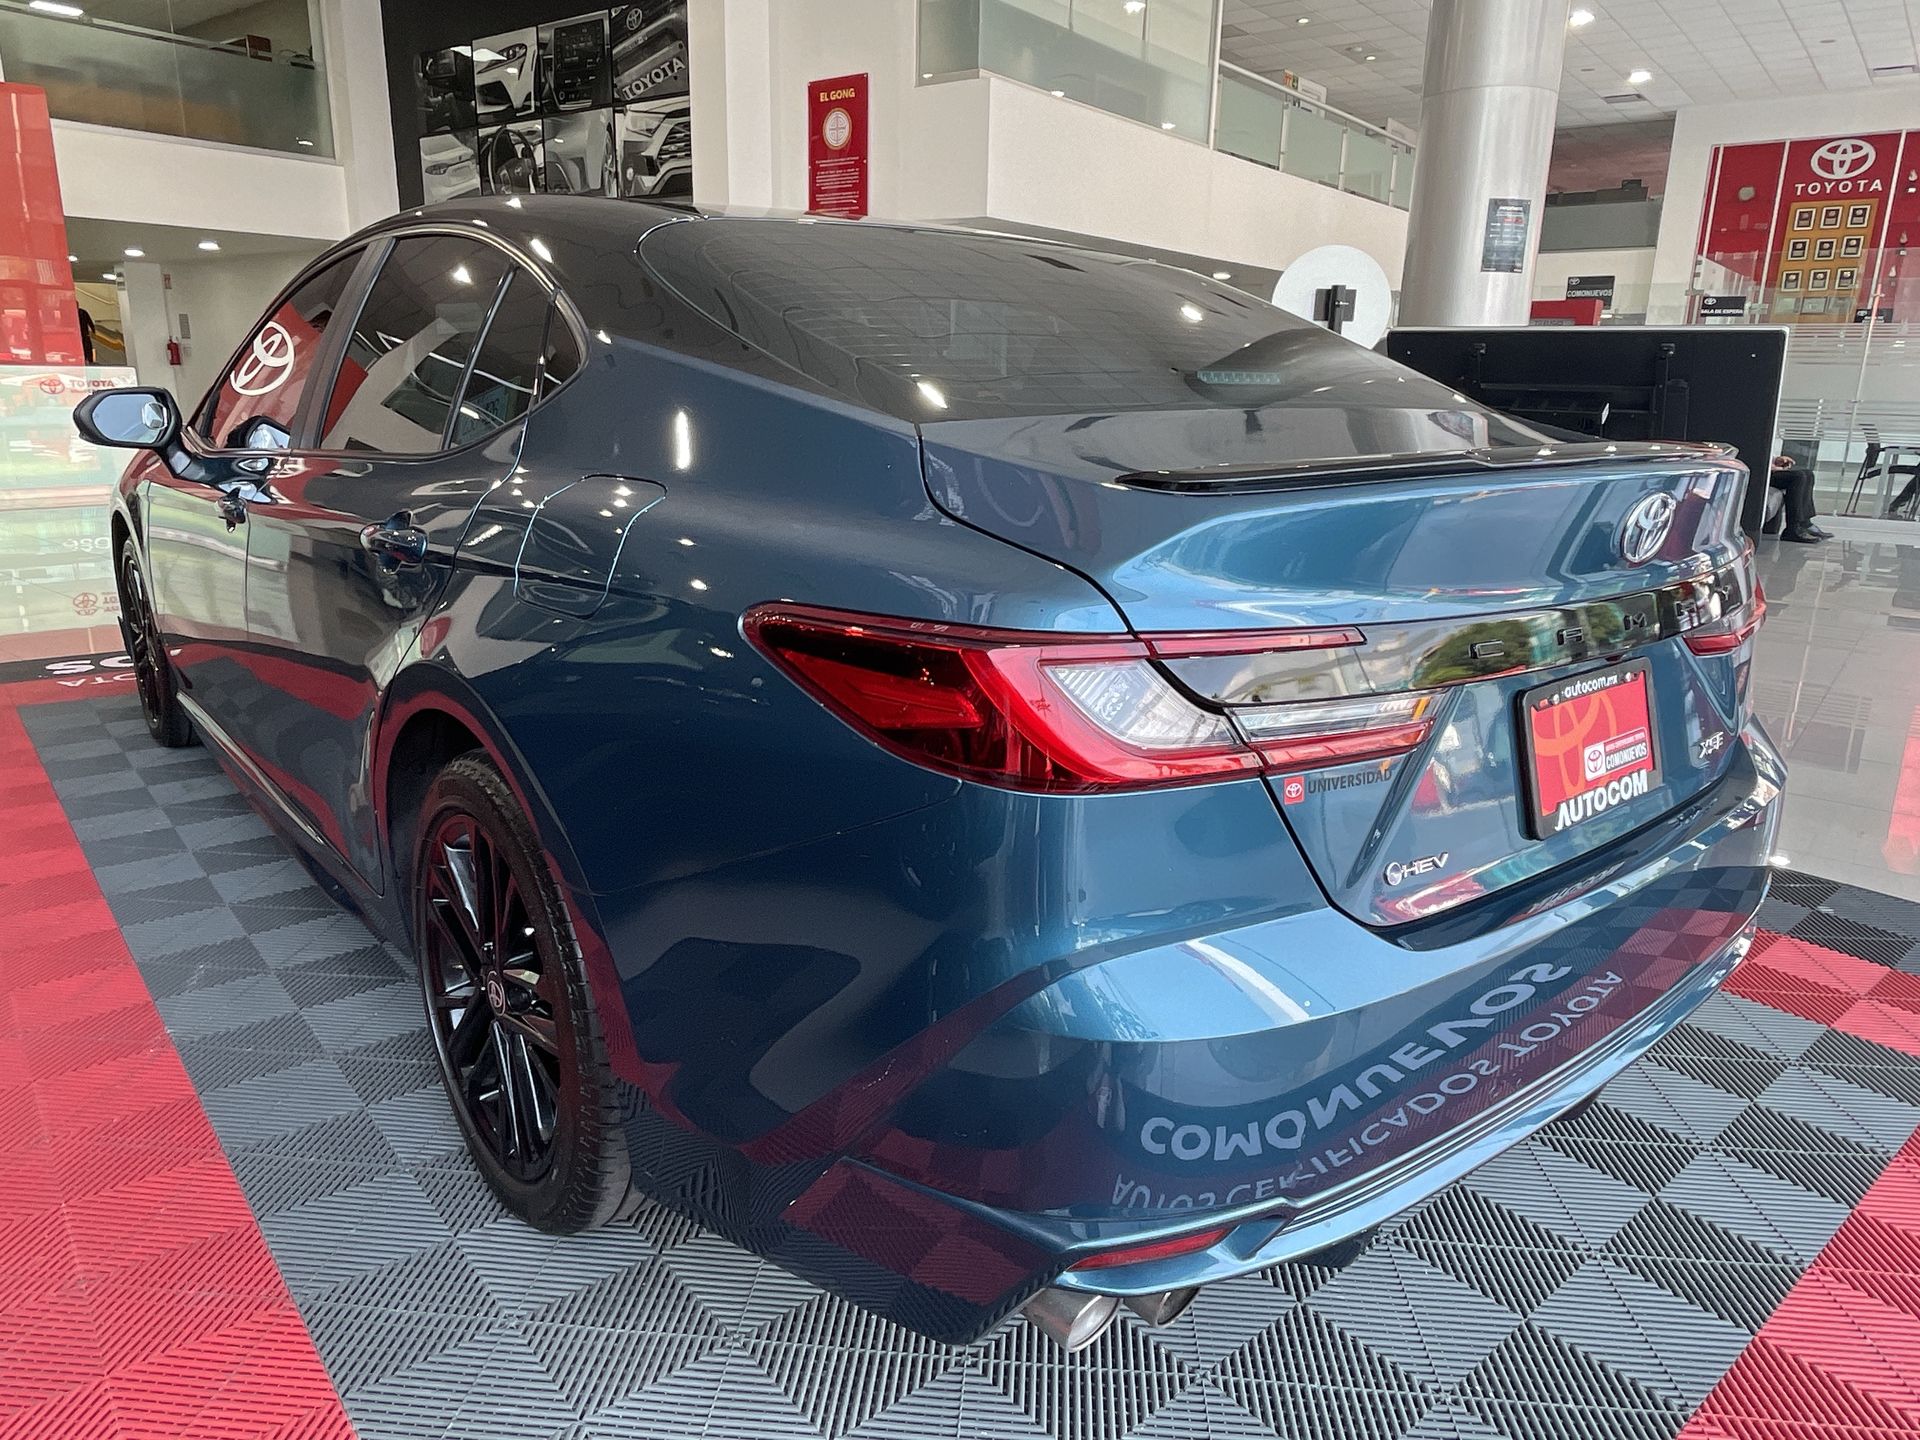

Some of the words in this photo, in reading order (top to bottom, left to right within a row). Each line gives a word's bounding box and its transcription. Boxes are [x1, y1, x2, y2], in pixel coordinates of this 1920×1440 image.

[622, 57, 685, 101] TOYOTA
[820, 92, 829, 102] EL
[830, 88, 855, 100] GONG
[1795, 180, 1882, 196] TOYOTA
[1567, 289, 1613, 298] COMONUEVOS
[70, 380, 115, 388] TOYOTA
[1606, 742, 1648, 770] COMONUEVOS
[1308, 770, 1392, 794] UNIVERSIDAD
[1555, 769, 1648, 831] AUTOCOM
